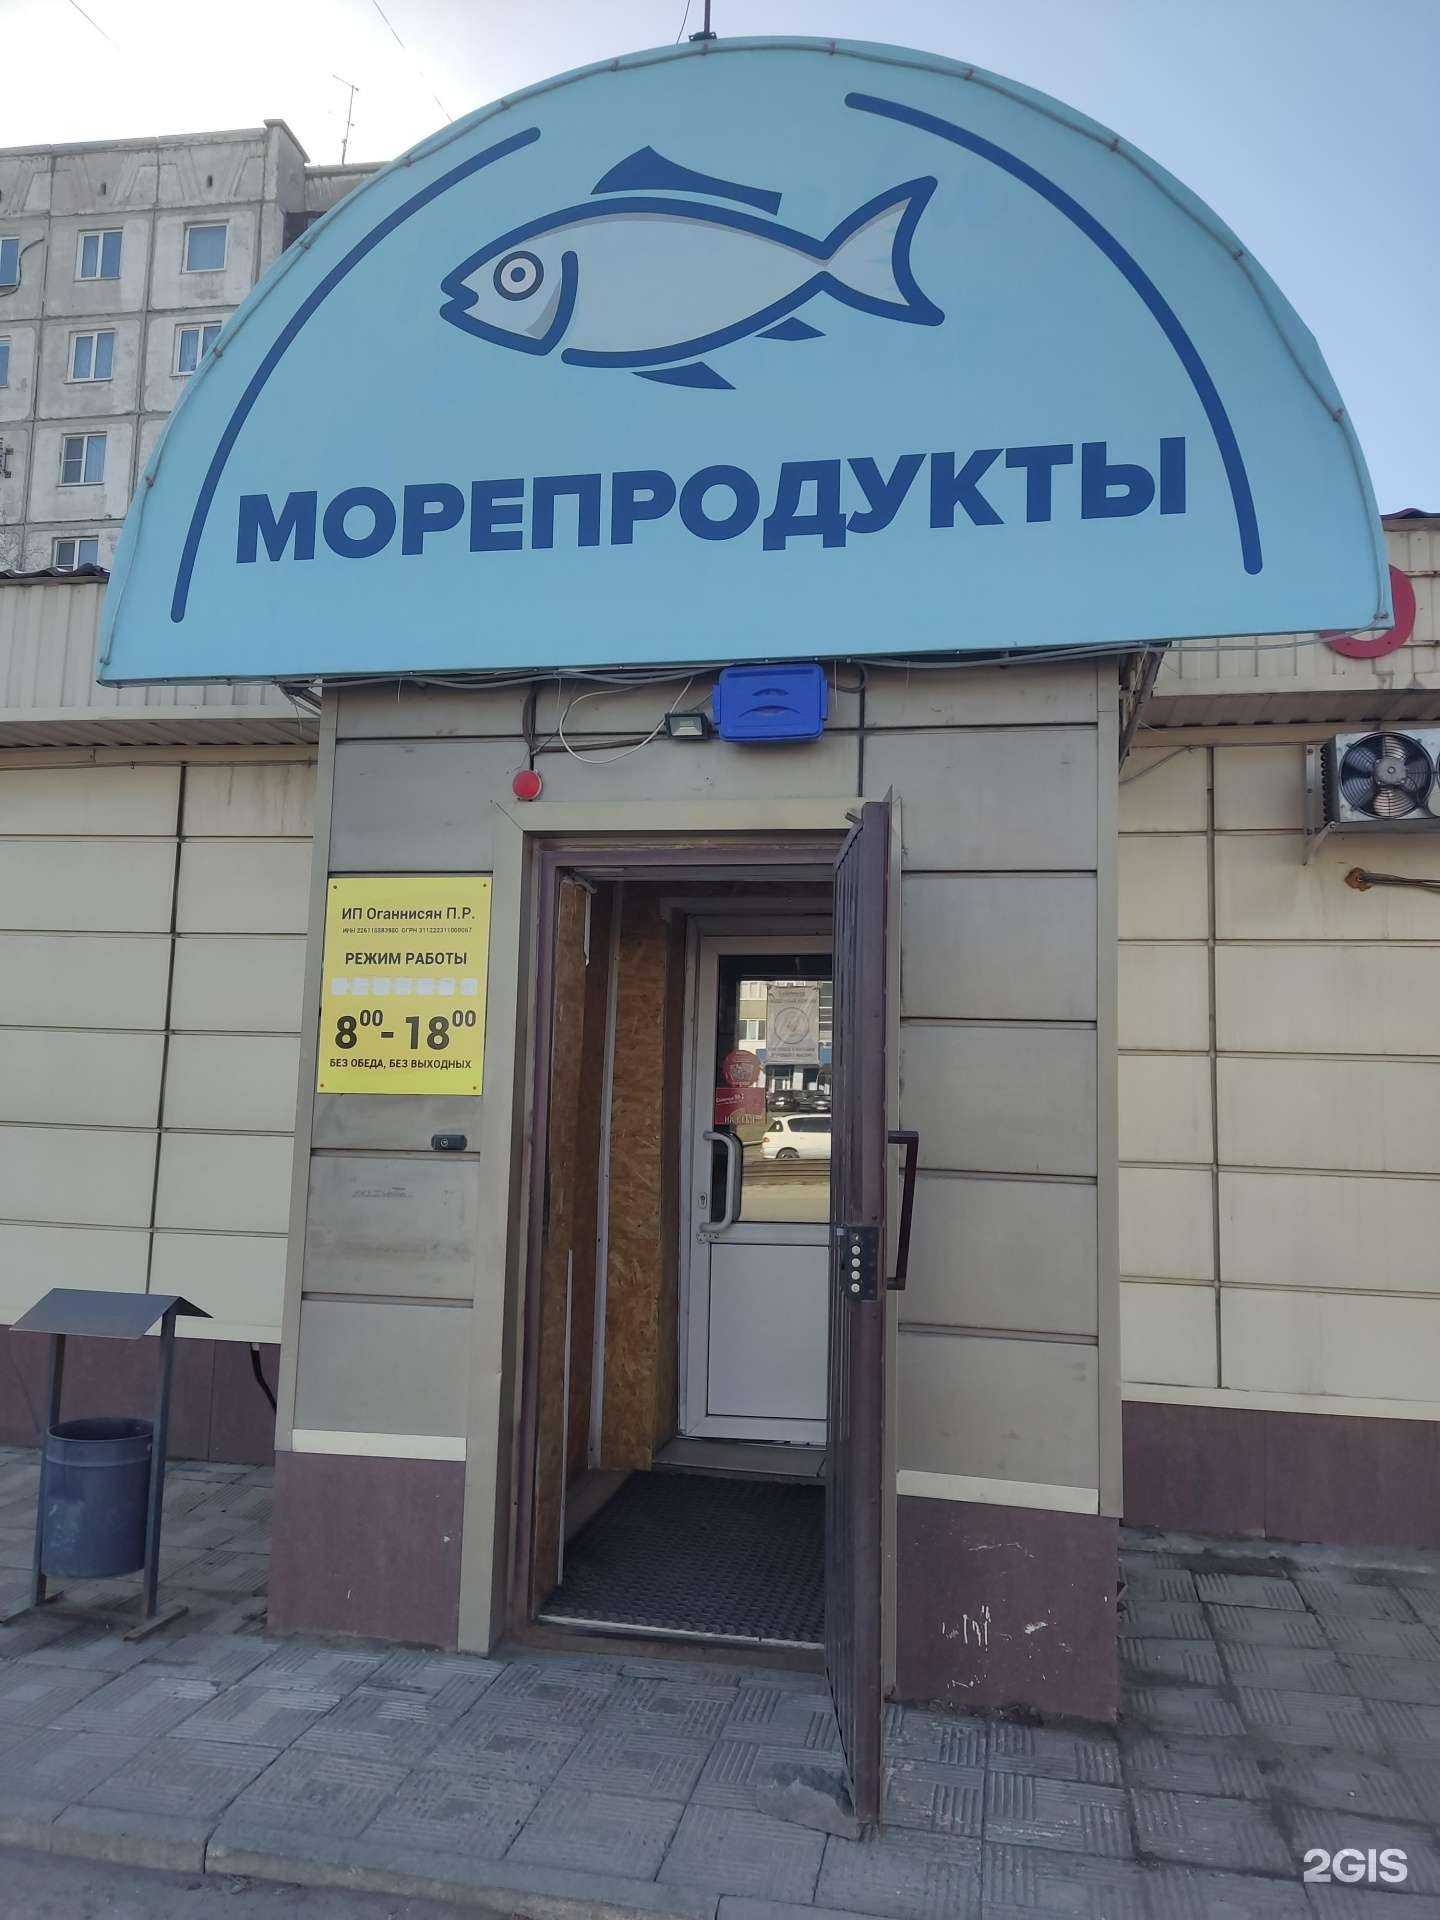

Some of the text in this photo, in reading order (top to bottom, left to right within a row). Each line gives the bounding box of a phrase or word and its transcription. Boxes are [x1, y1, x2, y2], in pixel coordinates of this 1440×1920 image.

[236, 436, 1187, 564] МОРЕПРОДУКТЫ
[341, 907, 476, 920] ИП Оганнисян П.Р.
[345, 952, 467, 965] РЕЖИМ РАБОТЫ
[330, 1058, 472, 1069] БЕЗ ОБЕДА, БЕЗ ВЫХОДНЫХ
